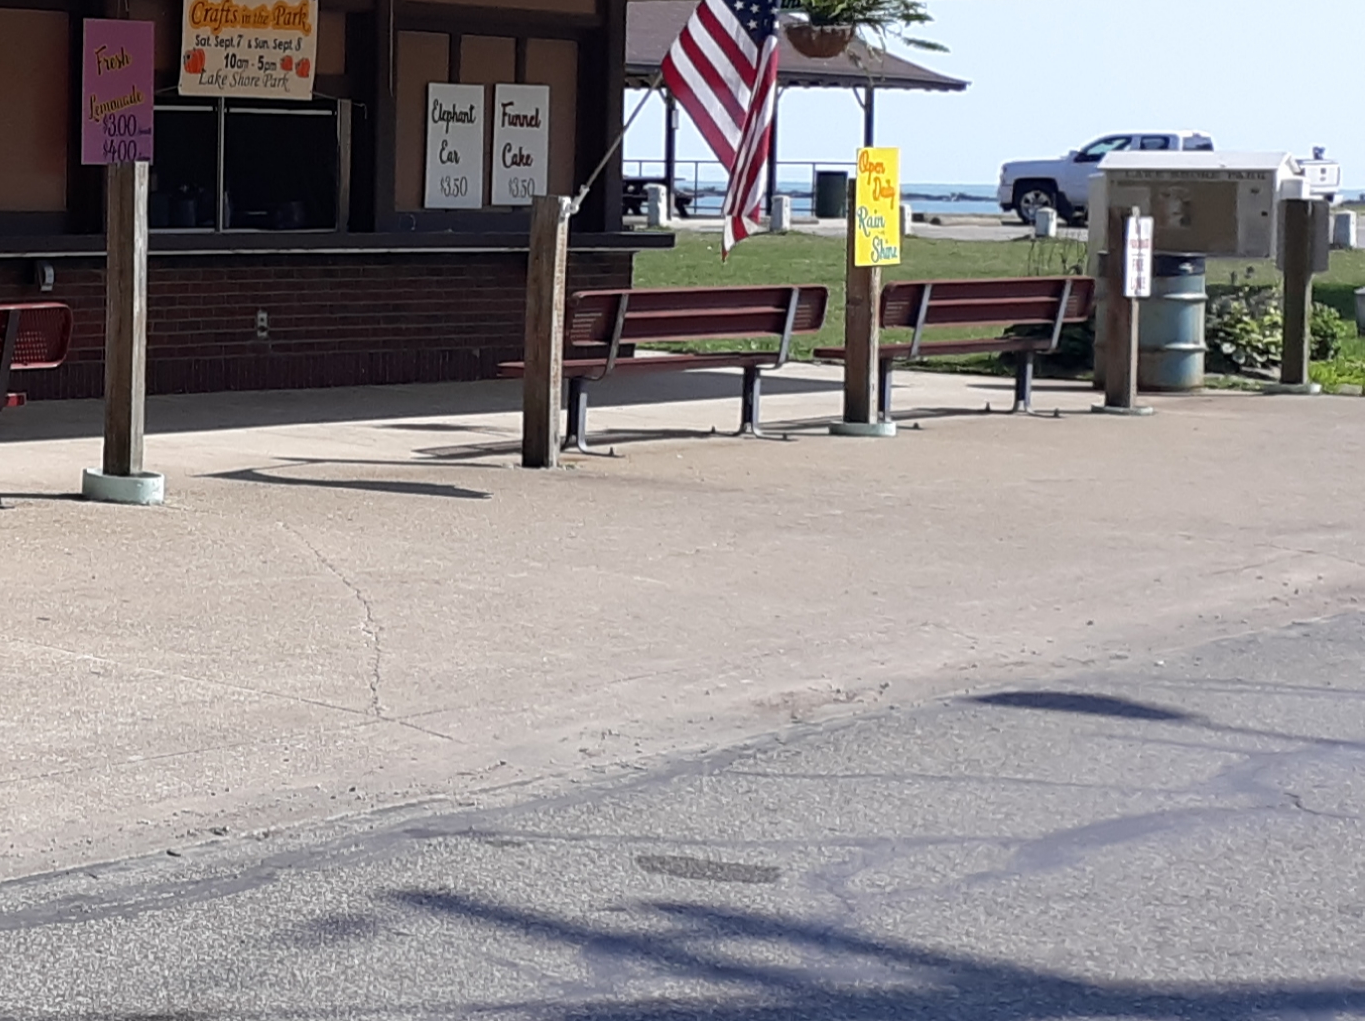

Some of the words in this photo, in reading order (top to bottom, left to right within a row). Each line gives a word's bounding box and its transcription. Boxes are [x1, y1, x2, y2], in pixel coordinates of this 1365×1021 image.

[192, 0, 239, 31] Crafts
[241, 9, 251, 25] in
[254, 10, 269, 25] the
[273, 3, 311, 31] Park
[237, 35, 244, 47] 7
[95, 45, 130, 75] Fresh
[224, 53, 249, 71] 10am
[257, 55, 277, 74] 5pm
[199, 67, 227, 90] Lake
[229, 69, 261, 87] Shore
[263, 72, 290, 92] Park
[89, 85, 143, 122] Lemonade
[432, 99, 476, 134] Elephant
[501, 101, 541, 129] Funnel
[103, 113, 136, 137] $3.00
[439, 140, 461, 165] Ear
[502, 143, 533, 168] Cake
[859, 150, 885, 185] Open
[440, 176, 468, 198] $3.50
[509, 177, 536, 198] $3.50
[872, 176, 895, 210] Daily
[857, 206, 885, 238] Rain
[871, 236, 898, 263] Shine
